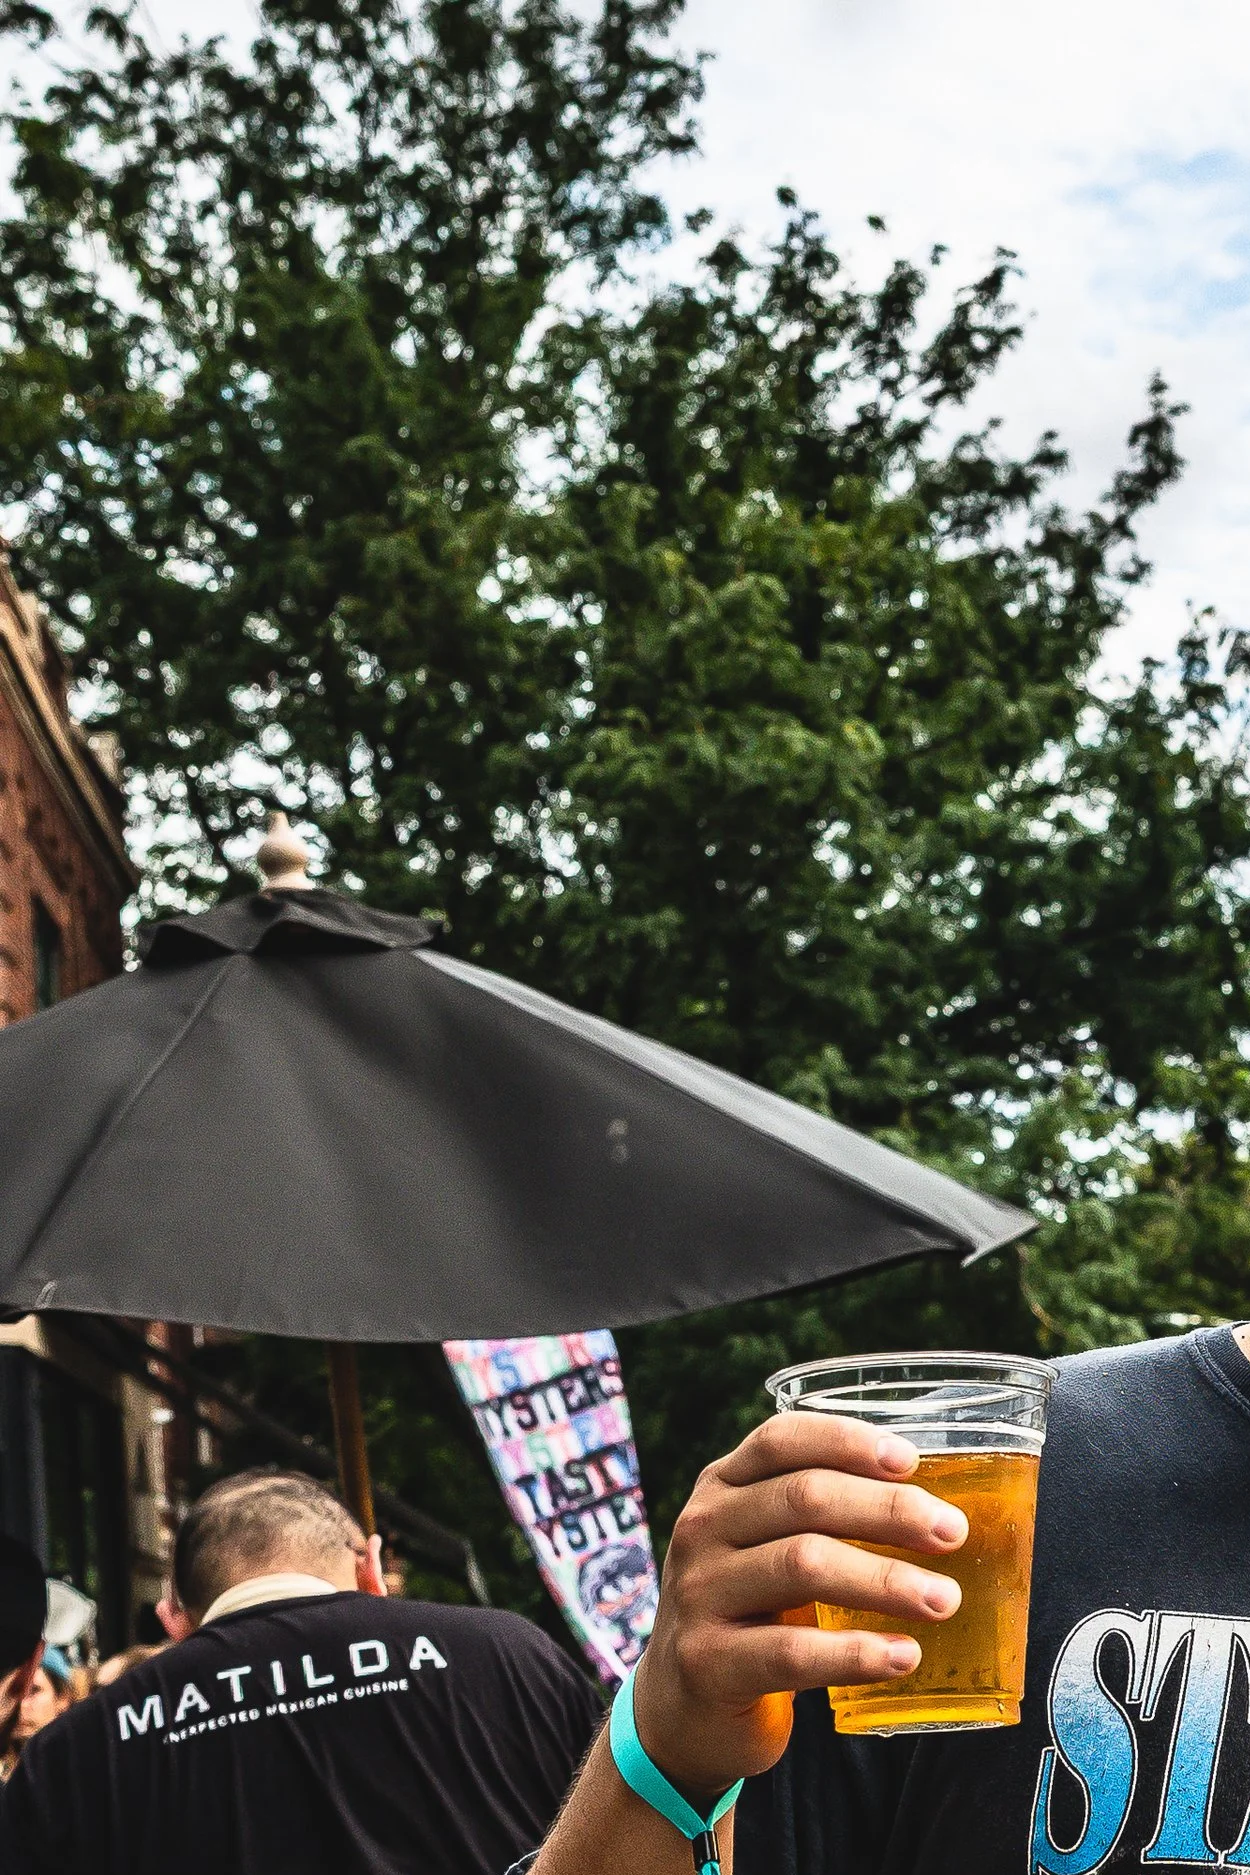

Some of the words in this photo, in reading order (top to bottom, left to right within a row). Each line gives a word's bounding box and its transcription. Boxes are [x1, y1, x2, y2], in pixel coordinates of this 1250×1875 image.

[117, 1636, 448, 1741] MATILDA
[163, 1708, 260, 1744] NEXPECTED
[265, 1692, 338, 1716] MEXICAN
[343, 1678, 409, 1701] CUISINE
